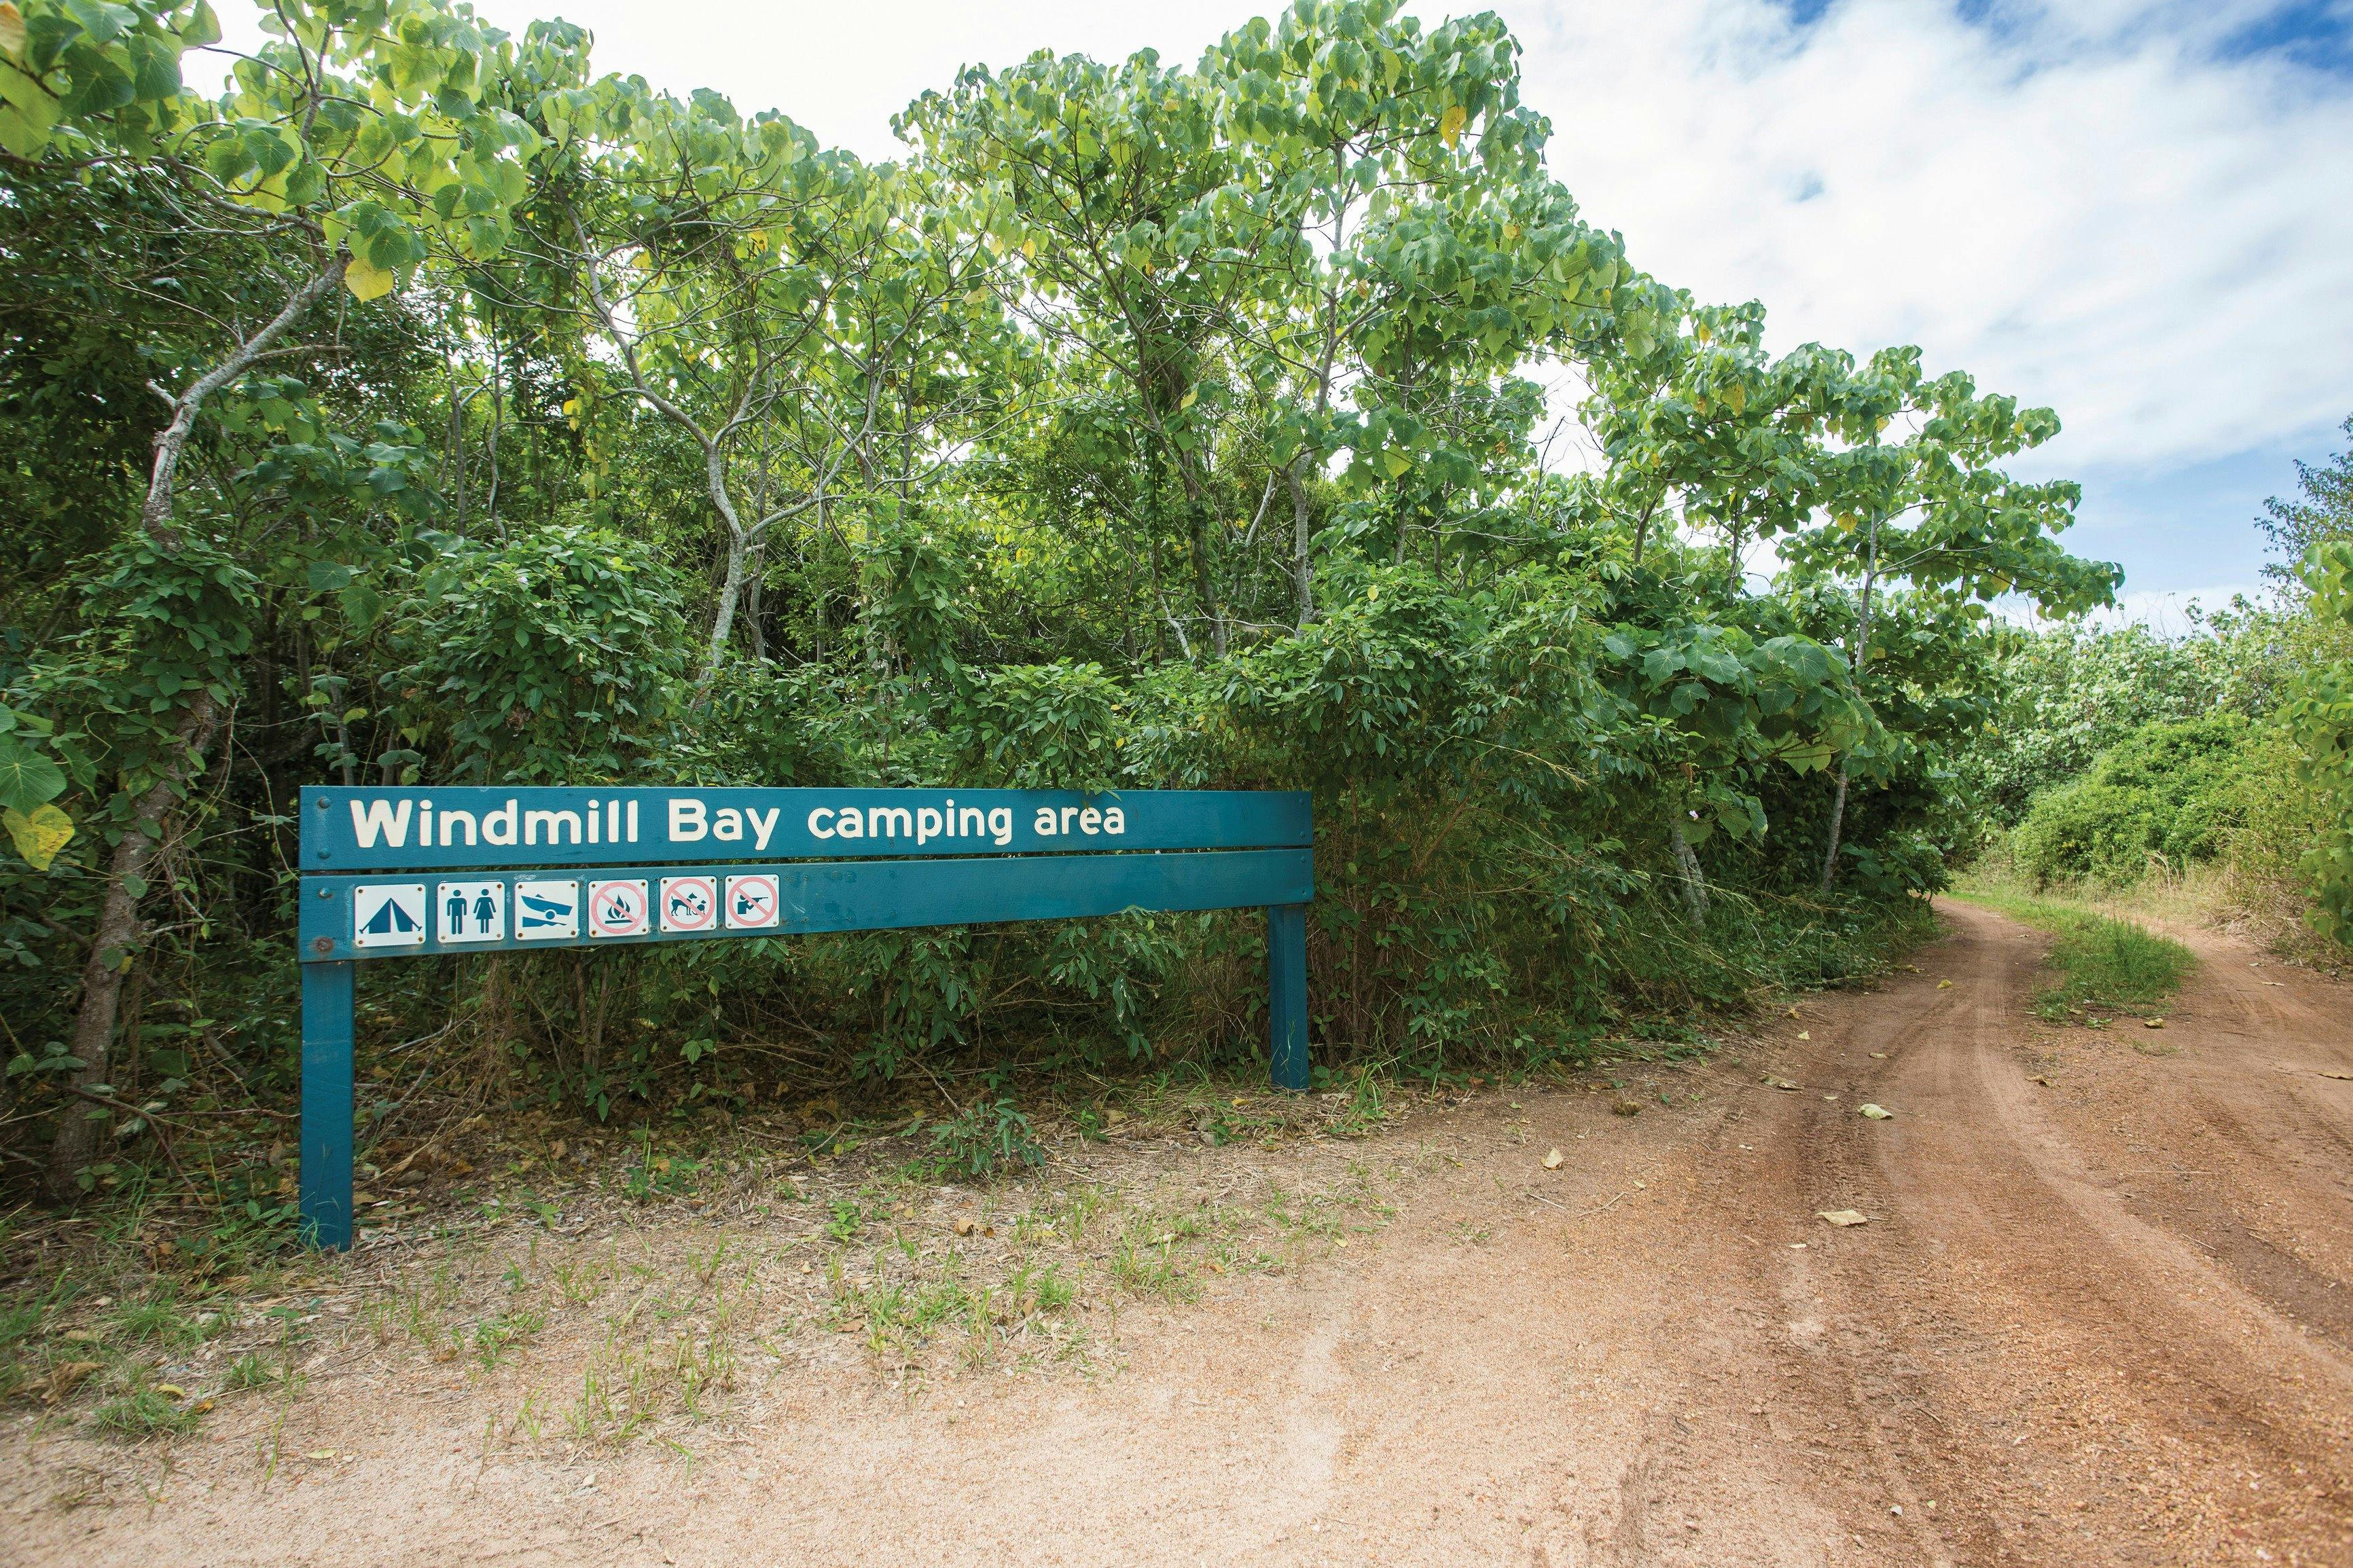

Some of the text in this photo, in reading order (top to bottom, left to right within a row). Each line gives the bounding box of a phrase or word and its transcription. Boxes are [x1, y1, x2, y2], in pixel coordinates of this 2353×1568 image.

[350, 799, 1126, 850] Windmill Bay camping area
